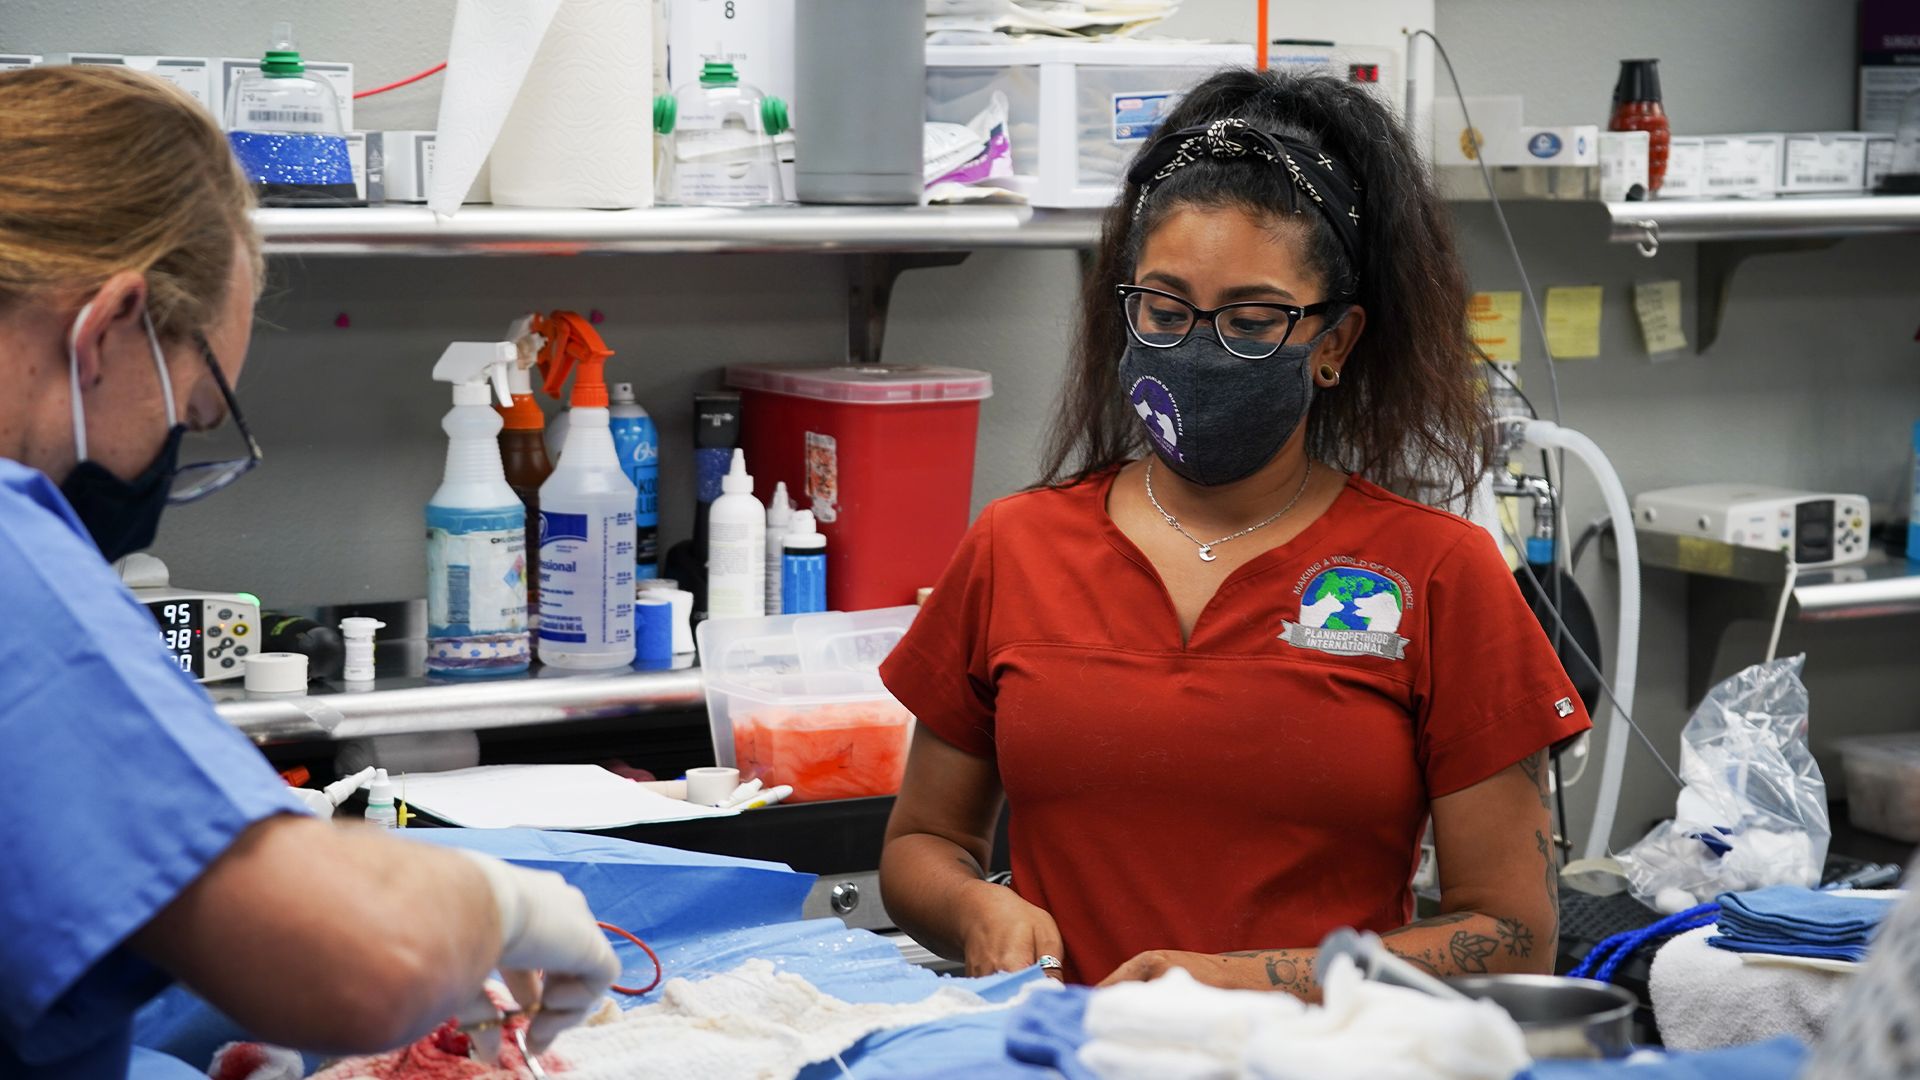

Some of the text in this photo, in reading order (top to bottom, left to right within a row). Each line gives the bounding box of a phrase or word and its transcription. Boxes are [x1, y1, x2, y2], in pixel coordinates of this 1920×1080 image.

[725, 1, 735, 19] 8
[1293, 555, 1414, 610] MAKING A WORLD OF DIFFERENCE
[163, 603, 191, 624] 95
[1306, 638, 1384, 655] INTERNATIONAL
